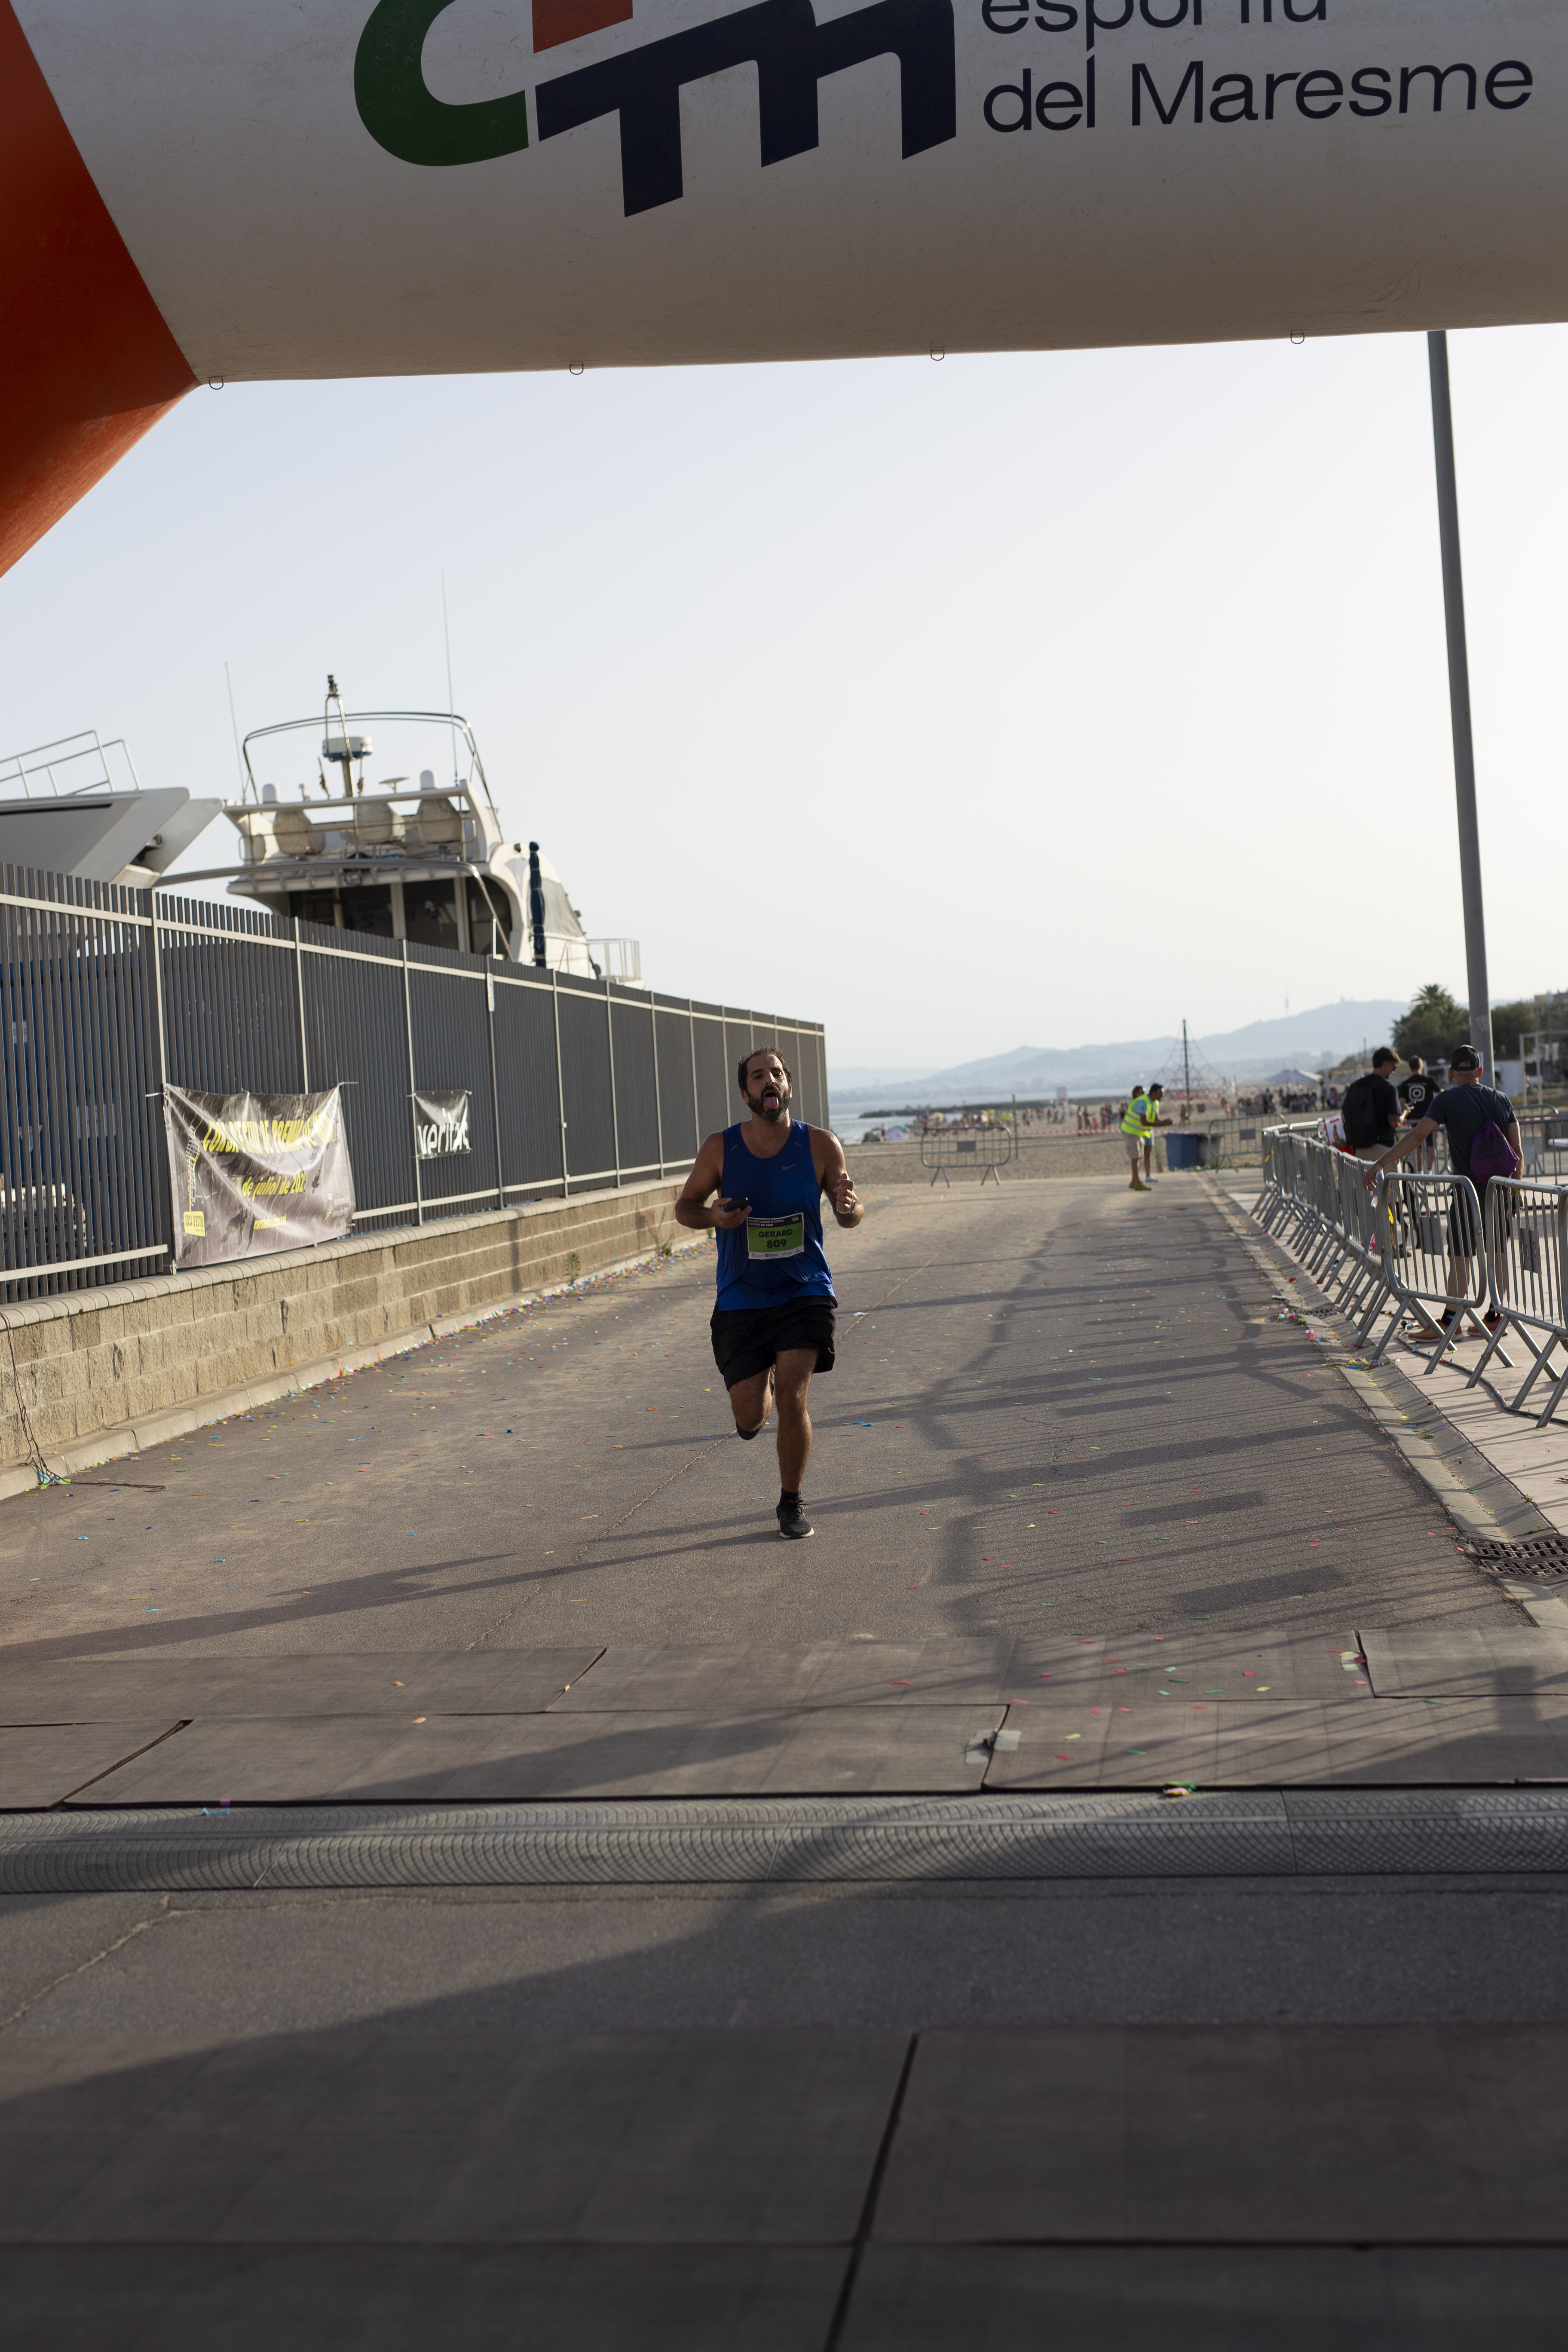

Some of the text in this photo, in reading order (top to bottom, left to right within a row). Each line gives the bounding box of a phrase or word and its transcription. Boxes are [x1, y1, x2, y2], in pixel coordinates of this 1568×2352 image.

[983, 54, 1534, 133] del Maresme
[242, 1176, 254, 1197] de
[251, 1175, 282, 1202] juliol
[279, 1175, 291, 1195] de
[758, 1228, 793, 1238] GERARD
[767, 1239, 787, 1249] 809
